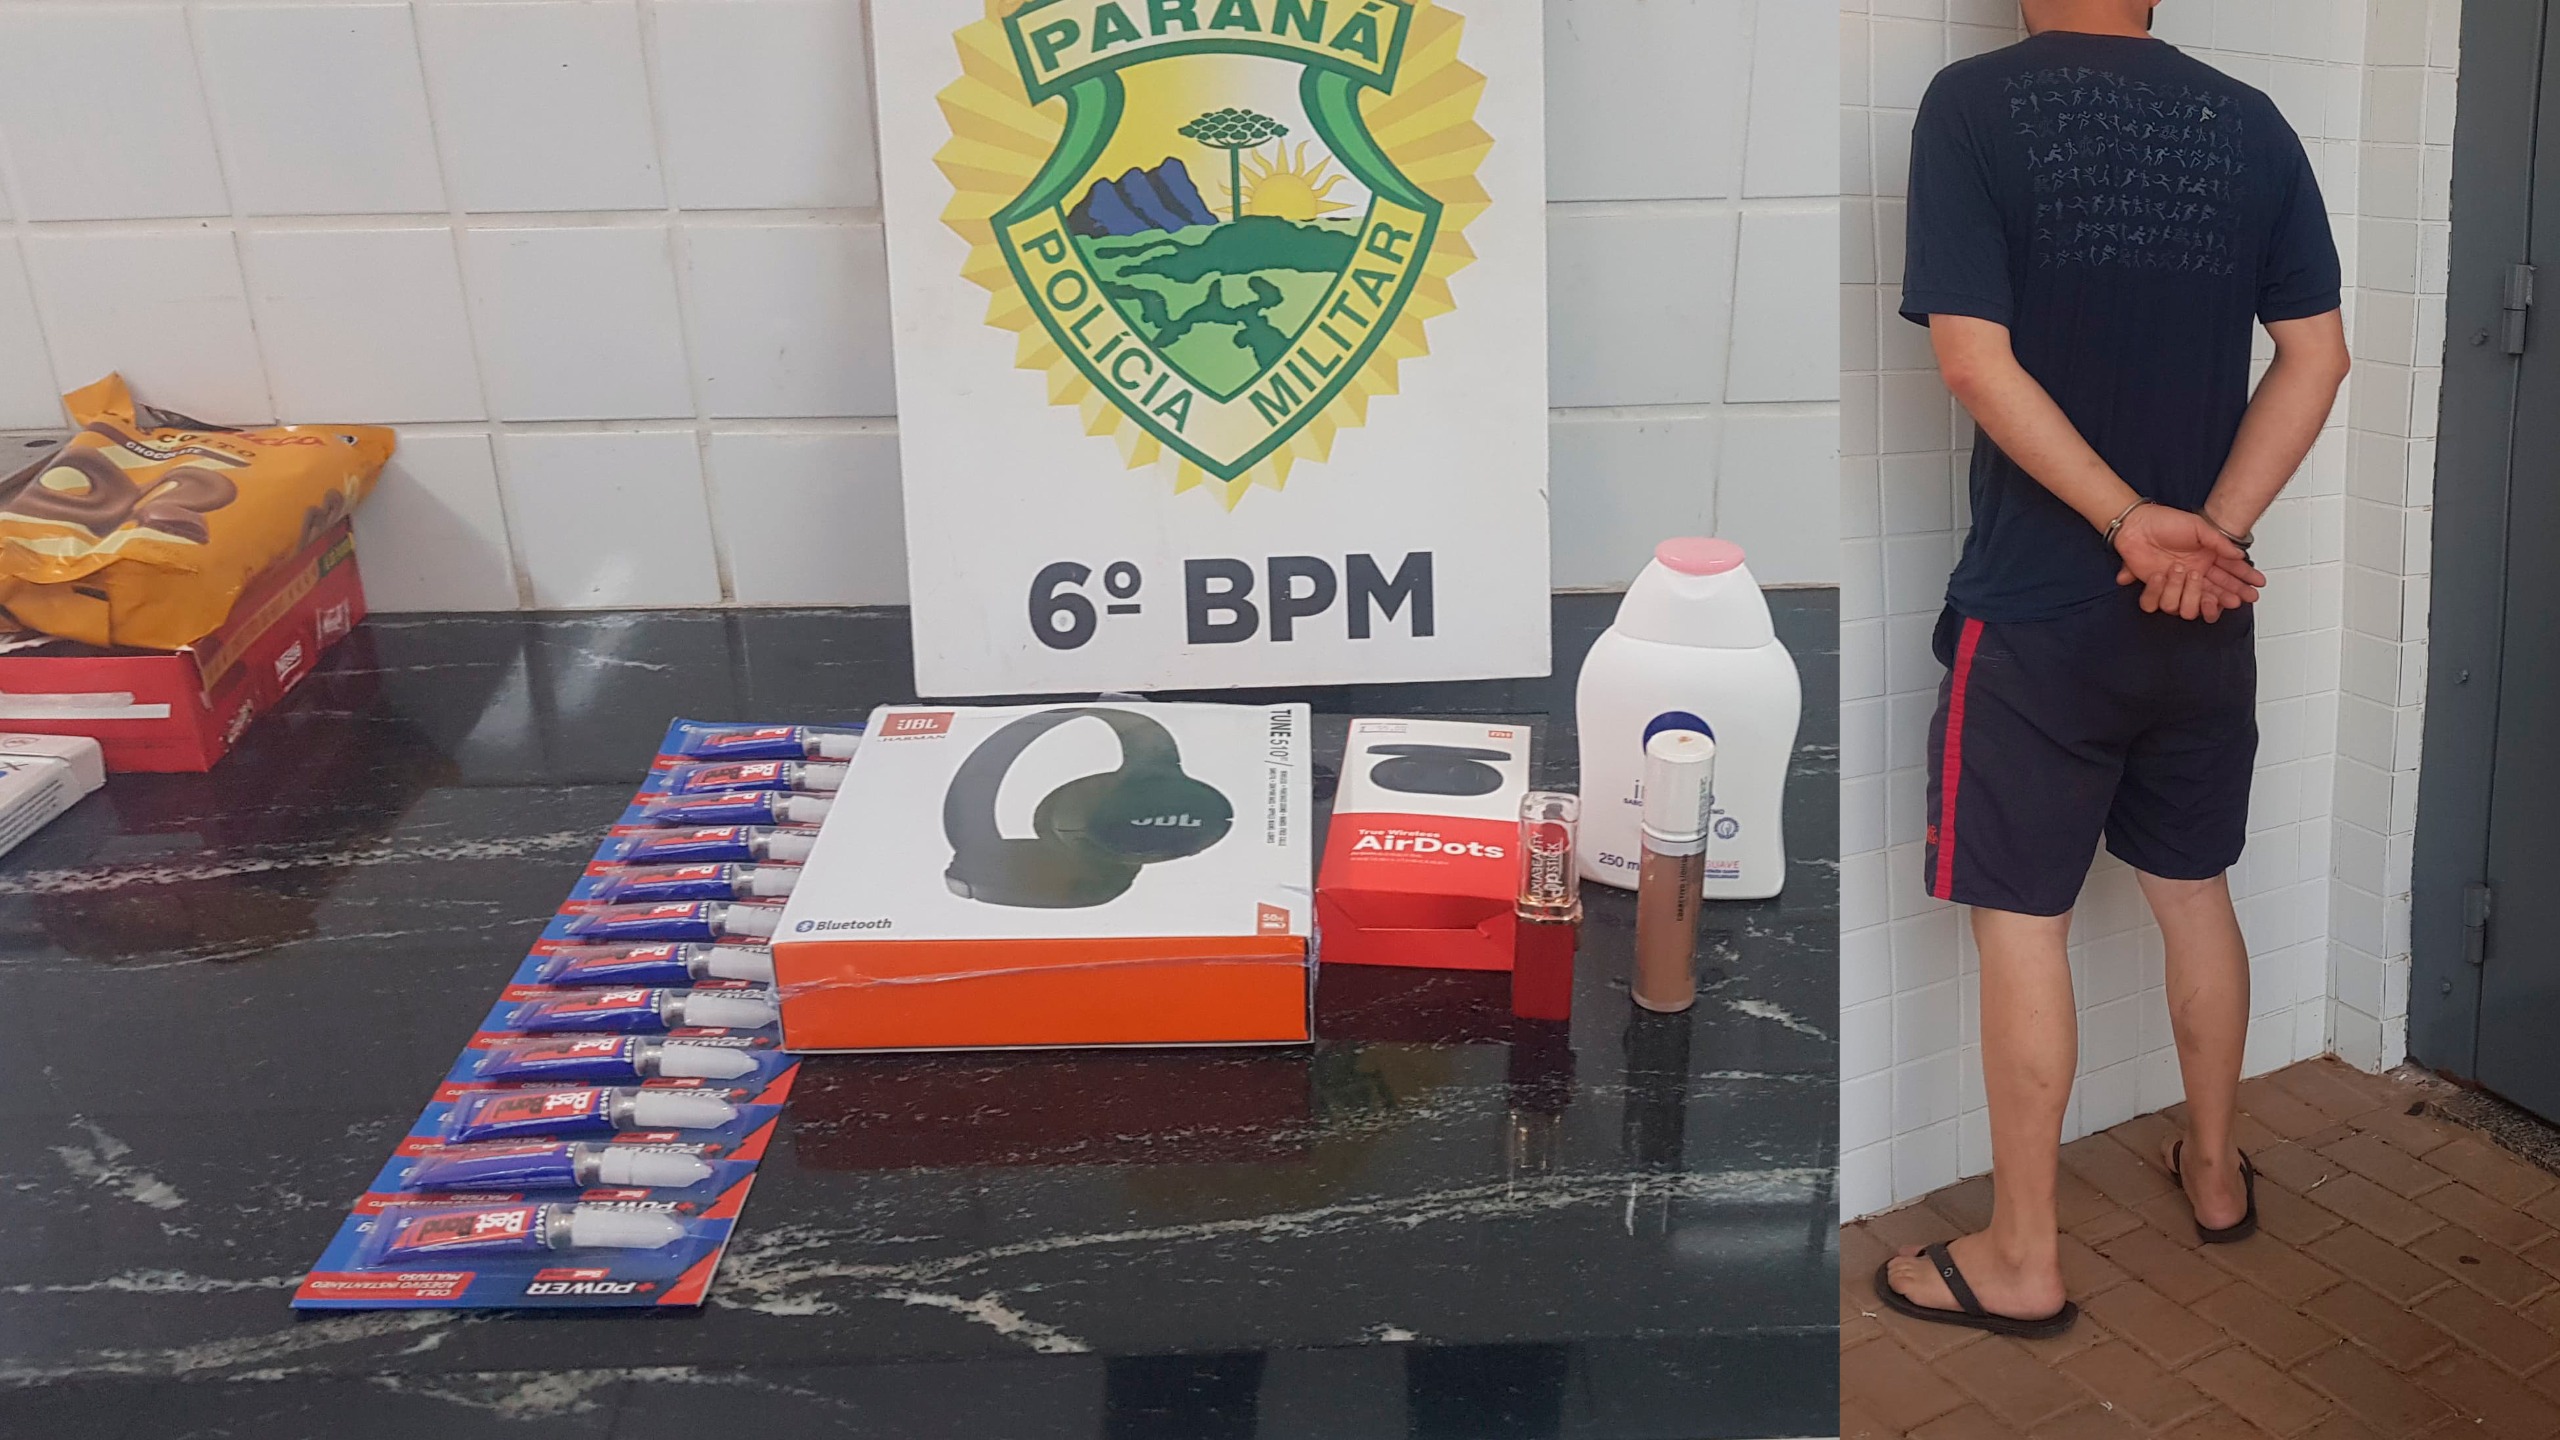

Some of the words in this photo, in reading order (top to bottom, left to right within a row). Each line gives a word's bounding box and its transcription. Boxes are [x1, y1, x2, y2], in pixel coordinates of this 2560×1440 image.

[1031, 0, 1382, 72] PARANÁ
[1021, 228, 1194, 435] POLÍCIA
[1248, 220, 1413, 430] MILITAR
[1184, 550, 1434, 646] BPM
[897, 718, 939, 730] JBL
[1269, 709, 1291, 737] TUNE
[1388, 829, 1440, 838] Wireless
[1352, 835, 1505, 859] AirDots
[1599, 852, 1625, 868] 250
[816, 918, 892, 931] Bluetooth
[545, 1090, 593, 1111] Best
[417, 1213, 477, 1241] Bond
[475, 1209, 527, 1234] Best
